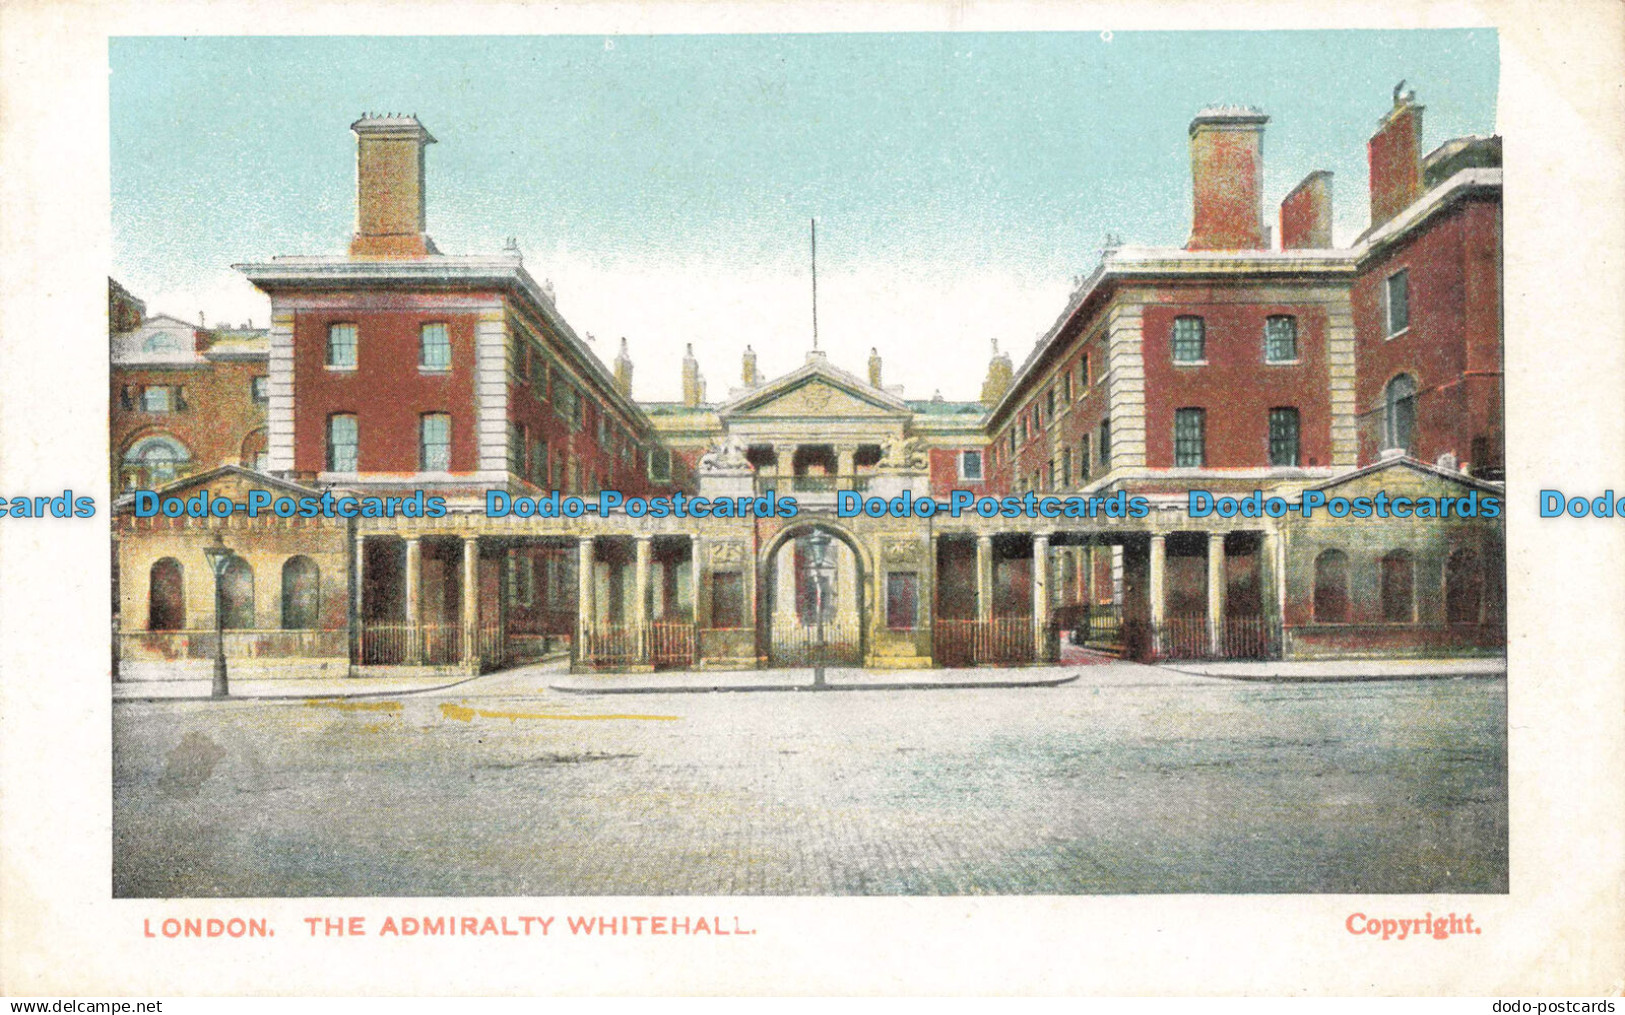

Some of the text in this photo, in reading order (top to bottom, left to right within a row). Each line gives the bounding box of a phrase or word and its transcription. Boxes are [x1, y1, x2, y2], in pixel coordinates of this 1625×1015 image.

[143, 914, 757, 939] LONDON. THE ADMIRALTY WHITEHALL.
[1345, 911, 1482, 941] Copyright.
